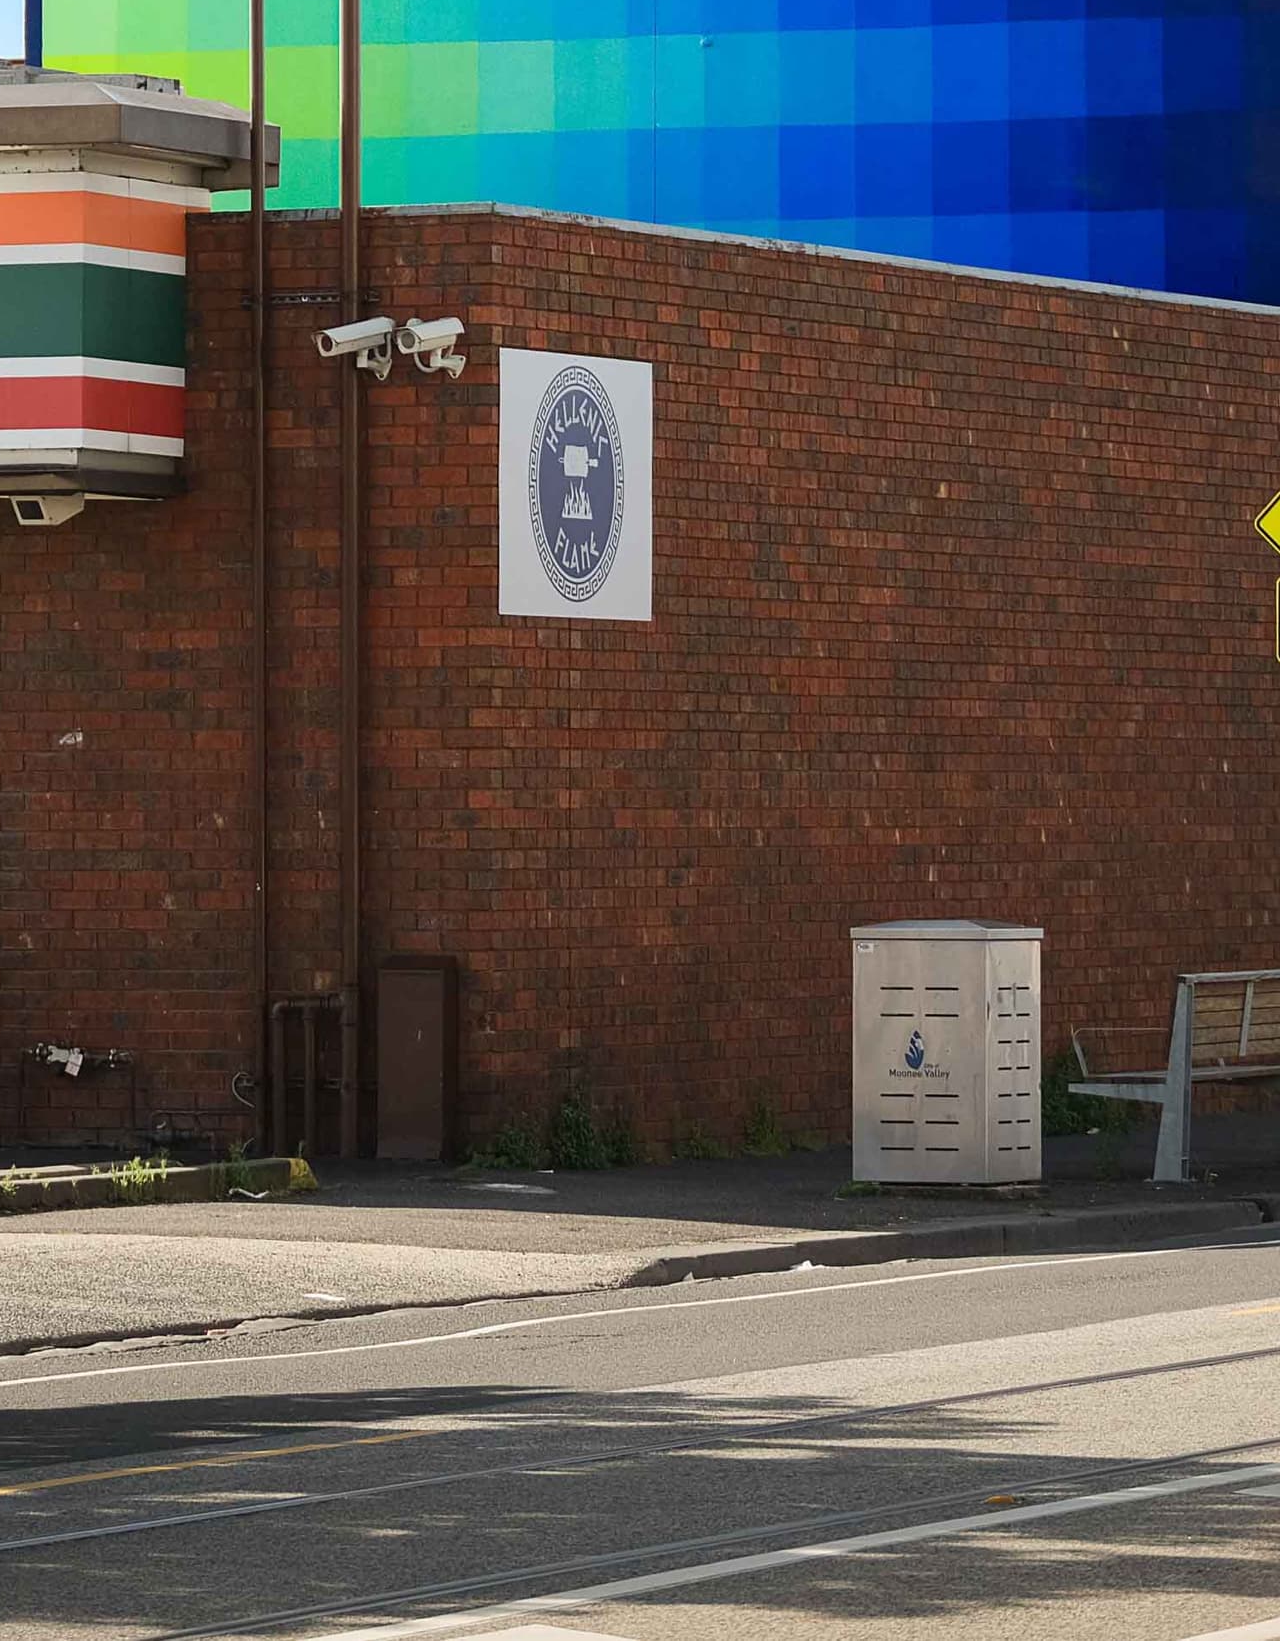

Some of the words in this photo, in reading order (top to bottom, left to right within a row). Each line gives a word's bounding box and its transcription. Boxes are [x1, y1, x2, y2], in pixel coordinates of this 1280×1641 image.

[545, 395, 609, 457] HELLENIC
[554, 527, 600, 574] FLAME
[889, 1069, 923, 1078] Moonee
[924, 1069, 950, 1079] Valley
